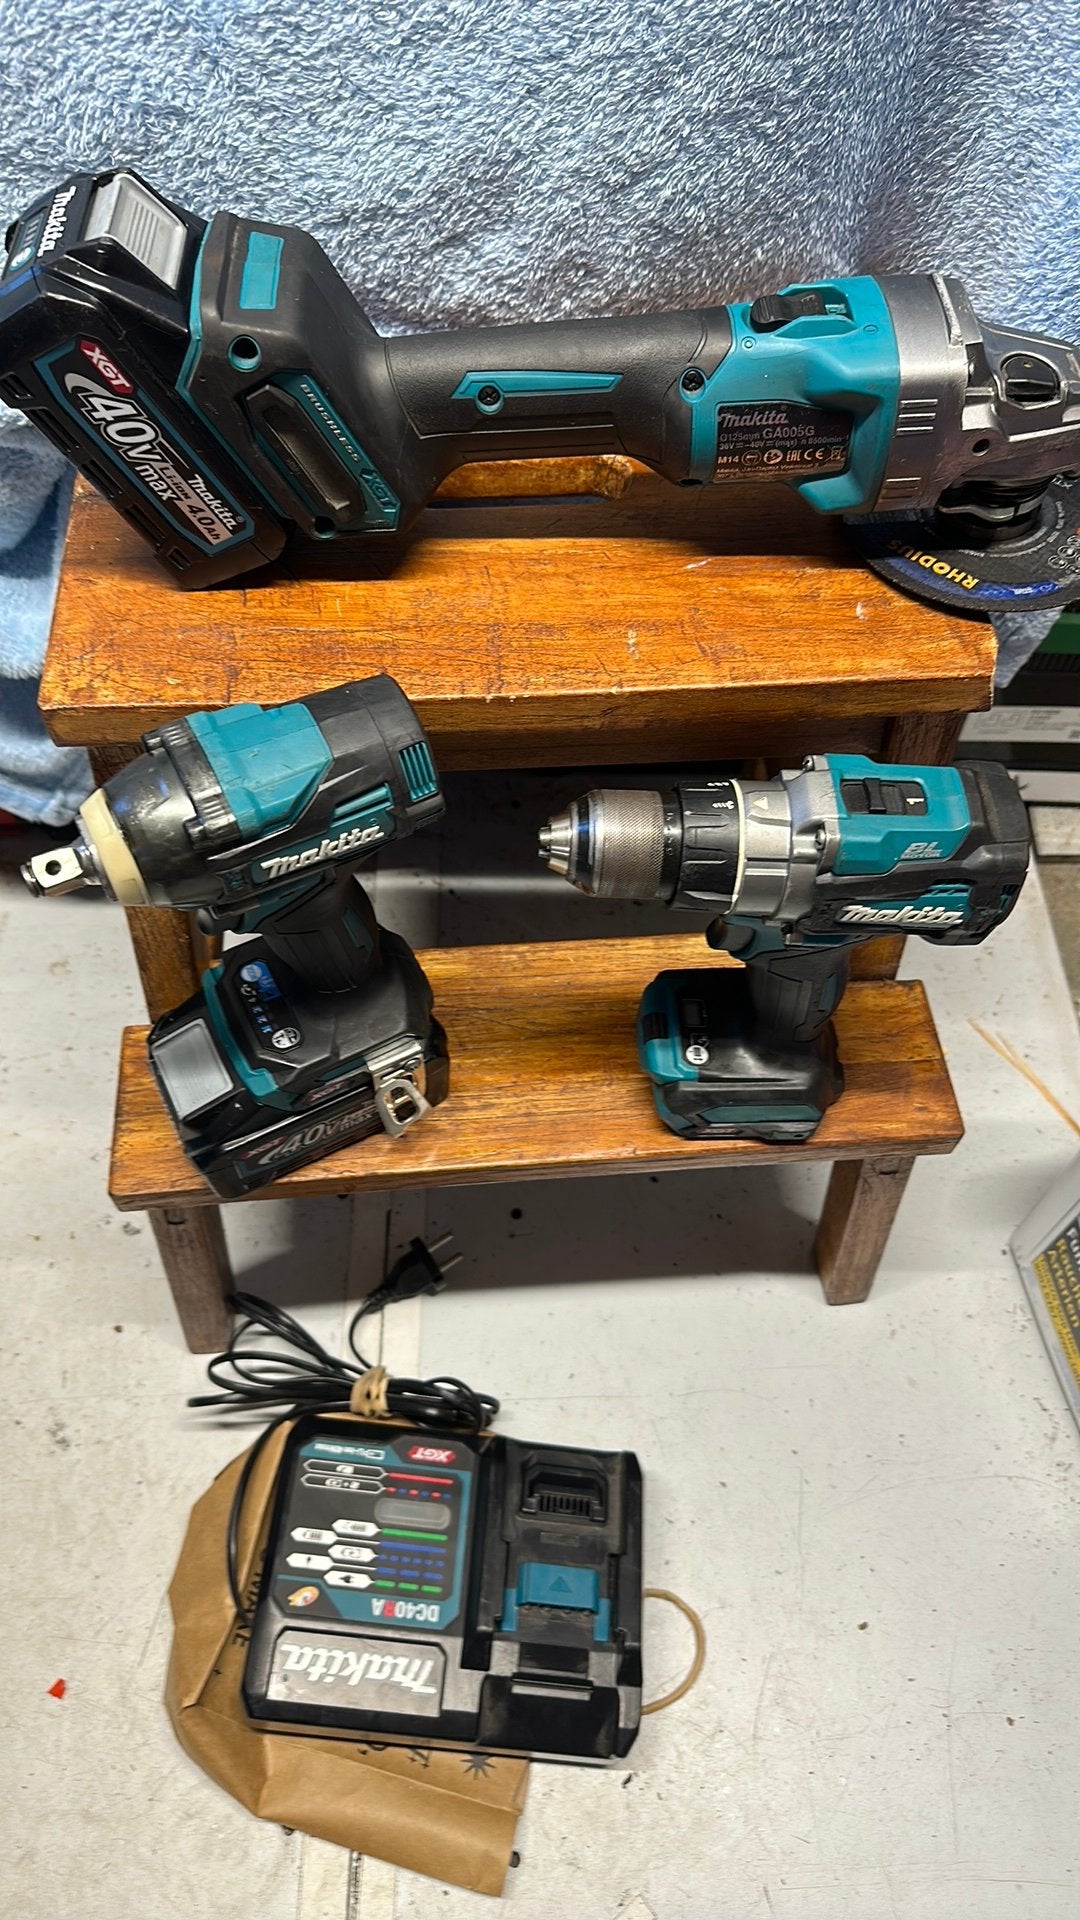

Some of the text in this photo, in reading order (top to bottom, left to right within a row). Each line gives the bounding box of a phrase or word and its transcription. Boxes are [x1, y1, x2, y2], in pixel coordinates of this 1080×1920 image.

[83, 346, 132, 390] XGT
[300, 384, 360, 462] BRUSHLESS
[762, 425, 815, 439] GA005G
[80, 391, 180, 501] 40V max
[718, 455, 739, 465] M14
[186, 504, 221, 541] 4.0Ah
[886, 540, 980, 590] RHODIUS
[411, 1446, 452, 1464] XGT
